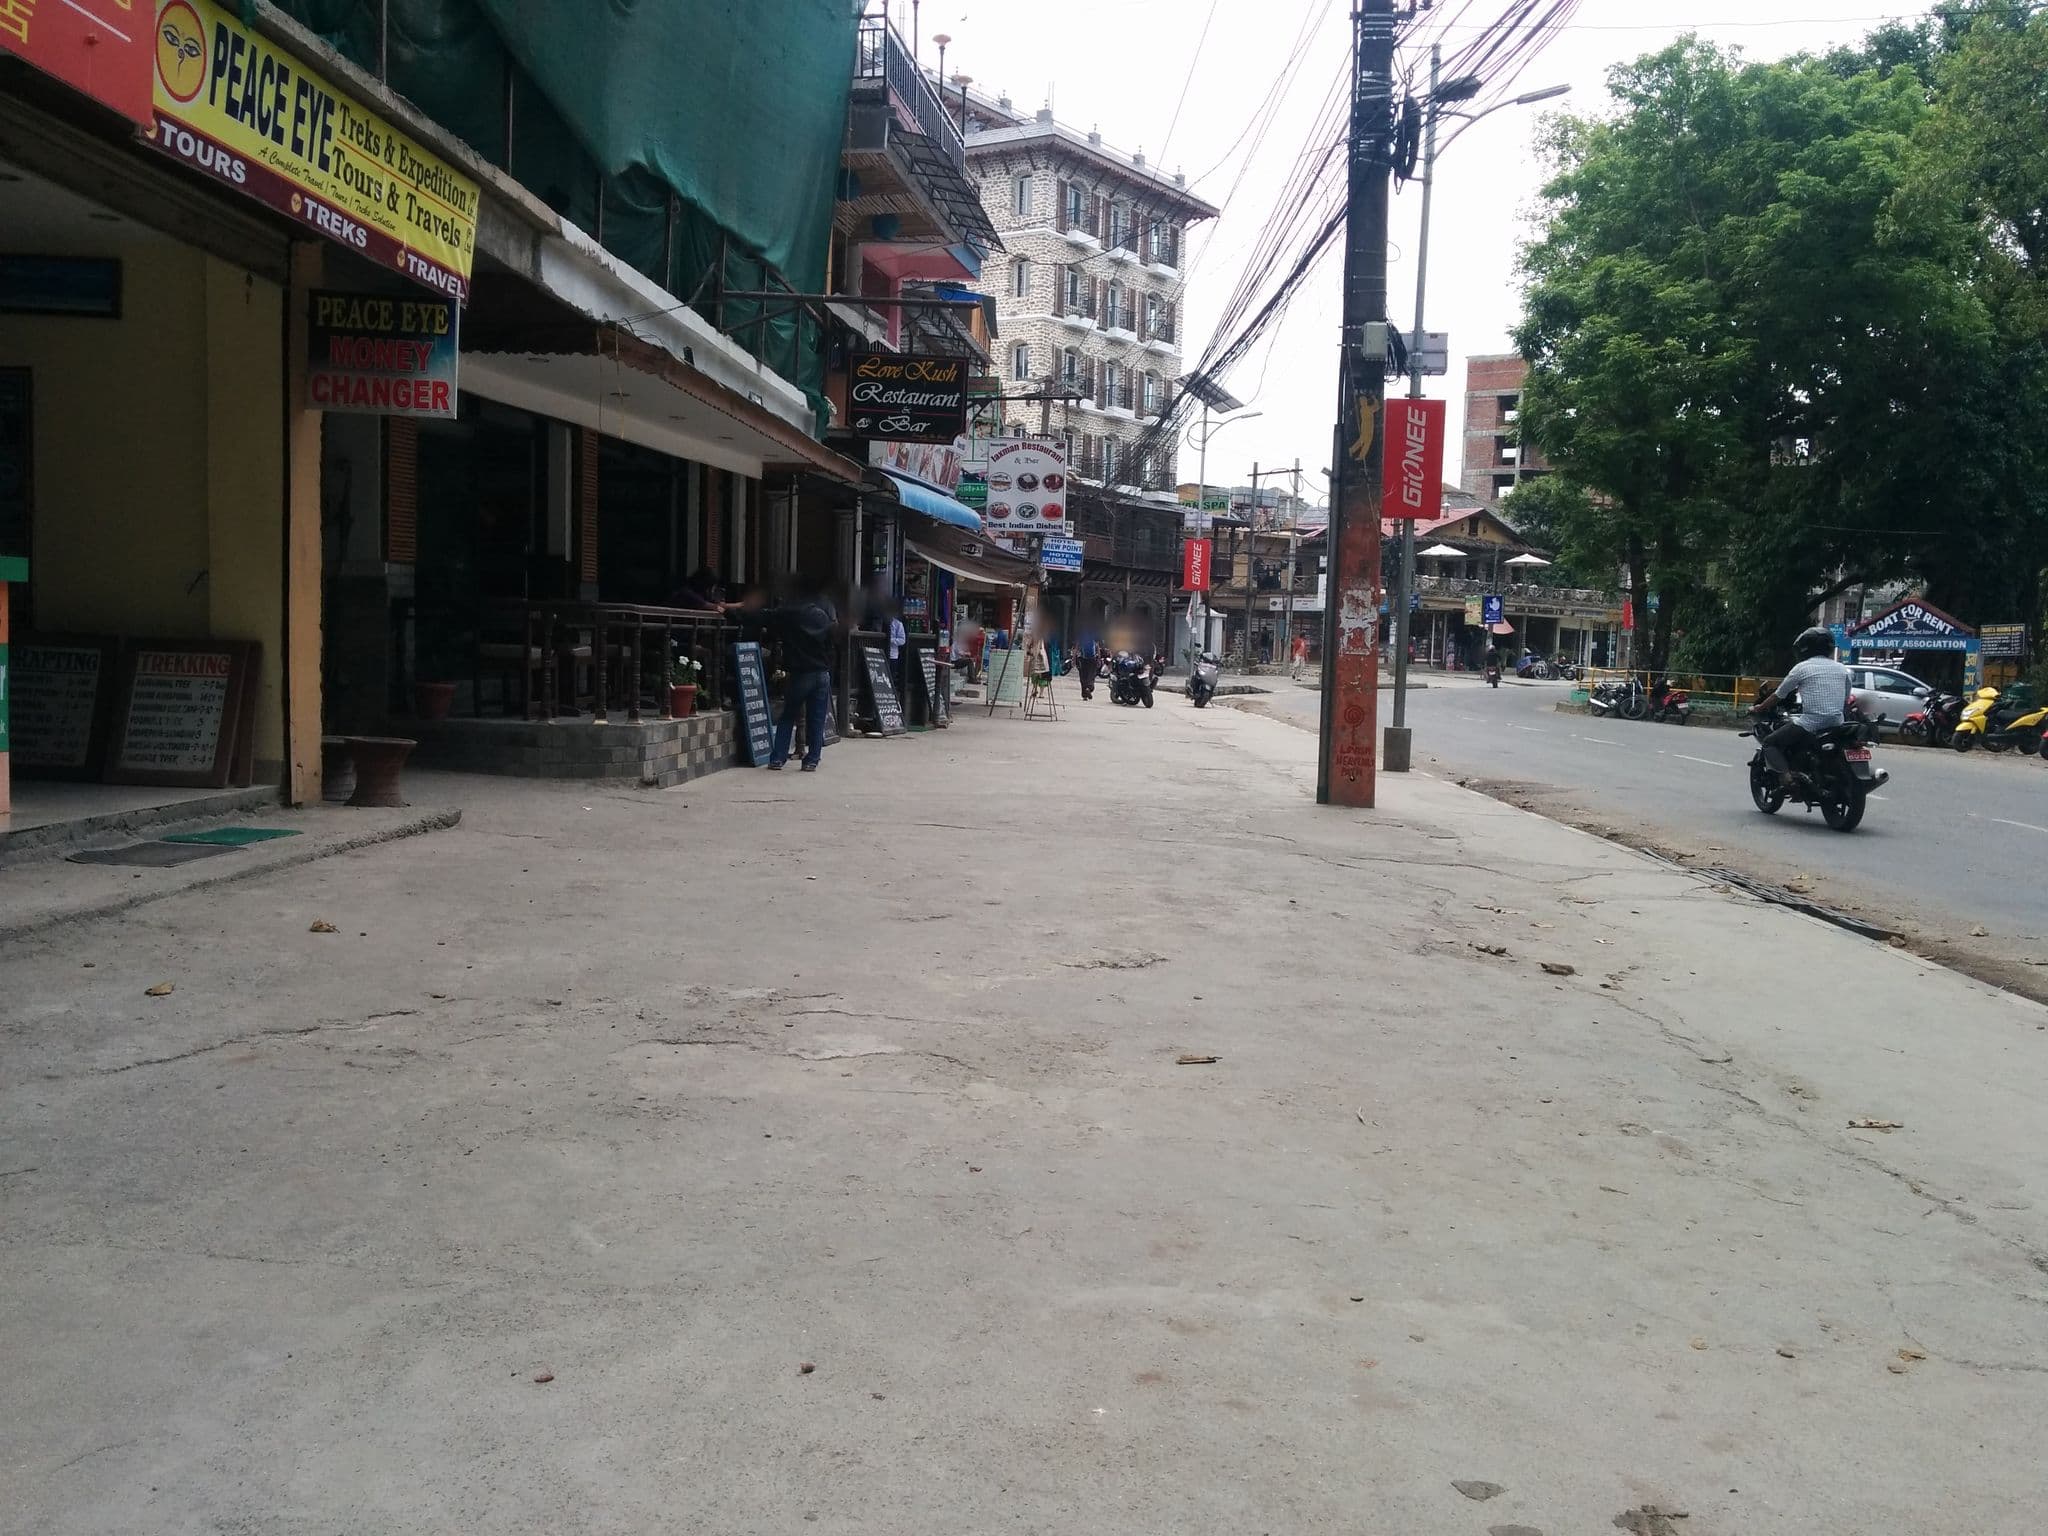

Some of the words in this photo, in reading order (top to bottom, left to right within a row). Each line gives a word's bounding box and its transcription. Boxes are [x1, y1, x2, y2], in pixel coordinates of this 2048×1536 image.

[209, 22, 290, 146] PEACE
[291, 75, 335, 173] EYE
[160, 120, 247, 185] TOURS
[258, 147, 269, 157] A
[269, 150, 301, 177] Complete
[339, 102, 381, 157] Treks
[384, 134, 396, 168] &
[398, 143, 467, 213] Expedition
[333, 146, 383, 203] Tours
[387, 182, 400, 215] &
[405, 191, 460, 247] Travels
[303, 197, 367, 248] TREKS
[407, 253, 466, 299] TRAVEL
[317, 297, 394, 330] PEACE
[400, 302, 449, 335] EYE
[330, 335, 433, 373] MONEY
[857, 357, 903, 378] Love
[905, 360, 958, 382] Kush
[311, 373, 450, 411] CHANGER
[853, 382, 961, 407] Restaurant
[879, 415, 931, 432] Bar
[1021, 442, 1064, 464] Restaurant
[1203, 501, 1226, 510] SPA
[988, 521, 1006, 529] Best
[1036, 522, 1063, 530] Dishes
[1062, 544, 1082, 552] POINT
[1868, 611, 1899, 635] BOAT
[1900, 604, 1922, 619] FOR
[1923, 611, 1954, 635] RENT
[1851, 639, 1874, 648] FEWA
[1877, 640, 1899, 648] BOAT
[1902, 640, 1967, 648] ASSOCIATION
[140, 654, 232, 675] TREKKING
